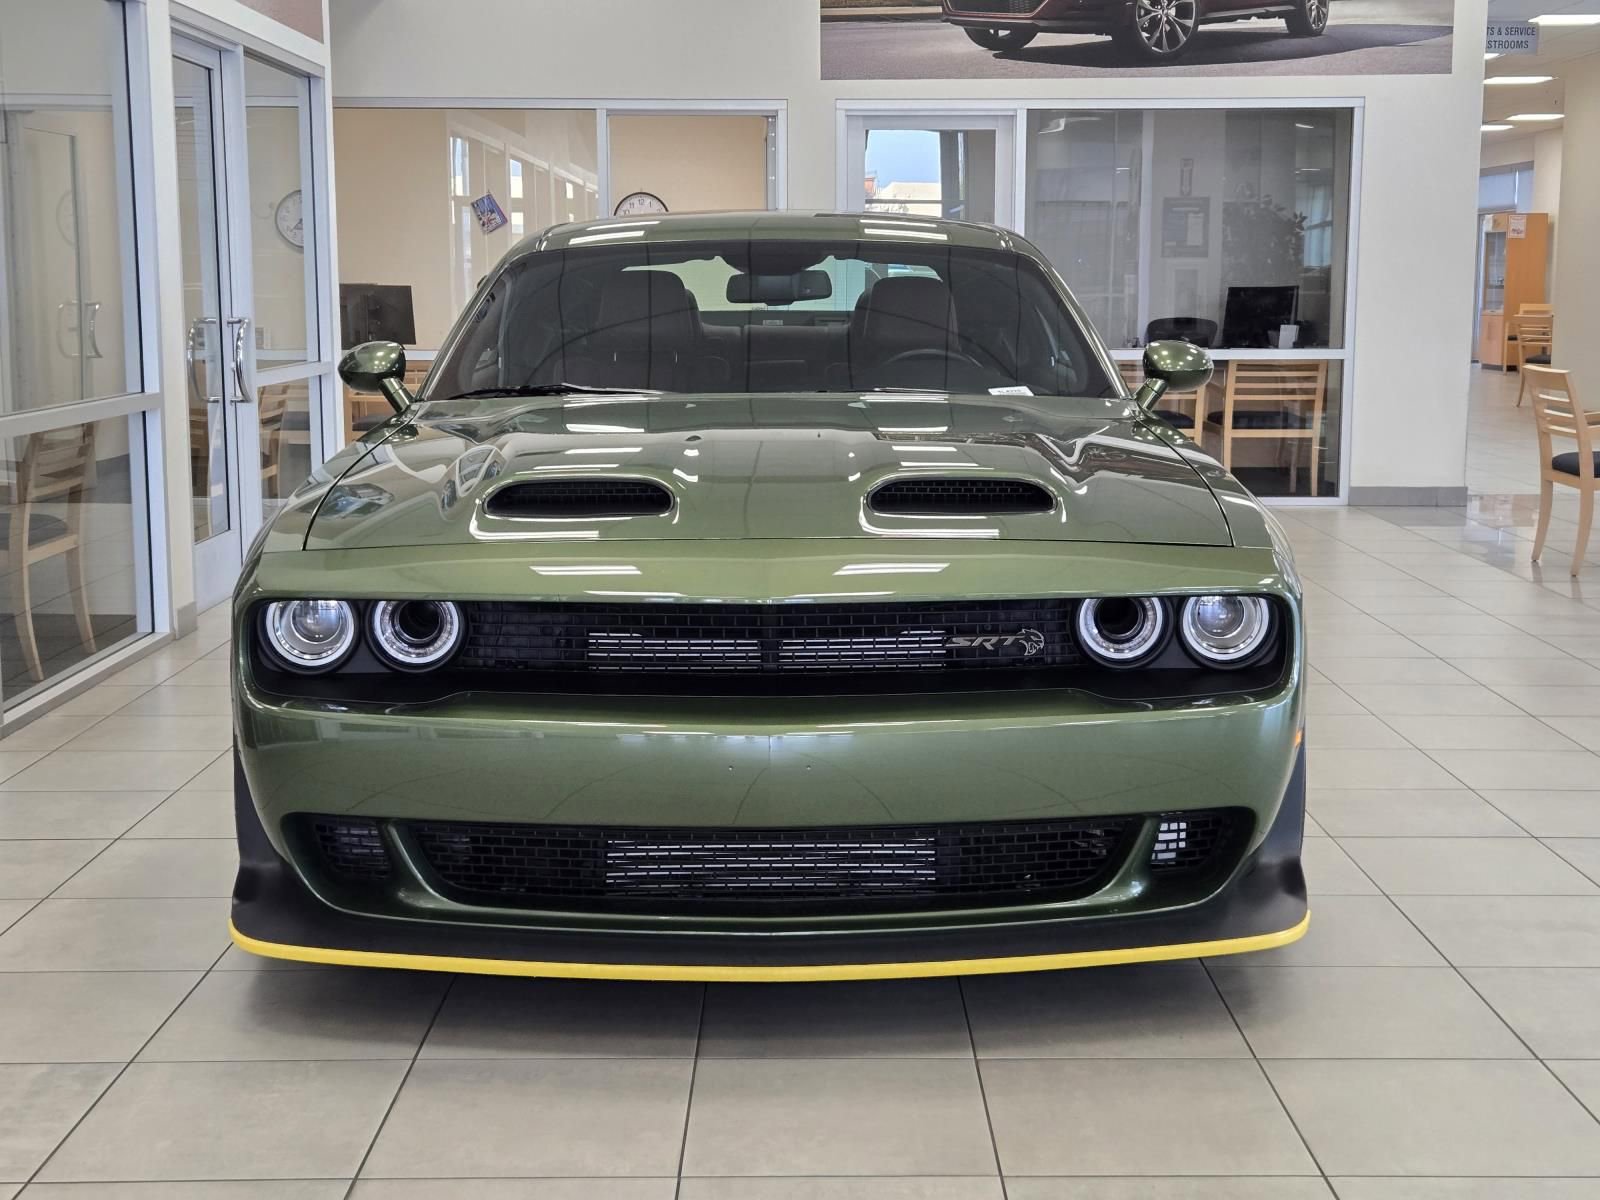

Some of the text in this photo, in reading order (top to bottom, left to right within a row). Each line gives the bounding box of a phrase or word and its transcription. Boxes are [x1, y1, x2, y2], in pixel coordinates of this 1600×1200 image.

[1497, 27, 1502, 36] &
[1504, 26, 1536, 36] SERVICE
[945, 635, 1025, 650] SRT
